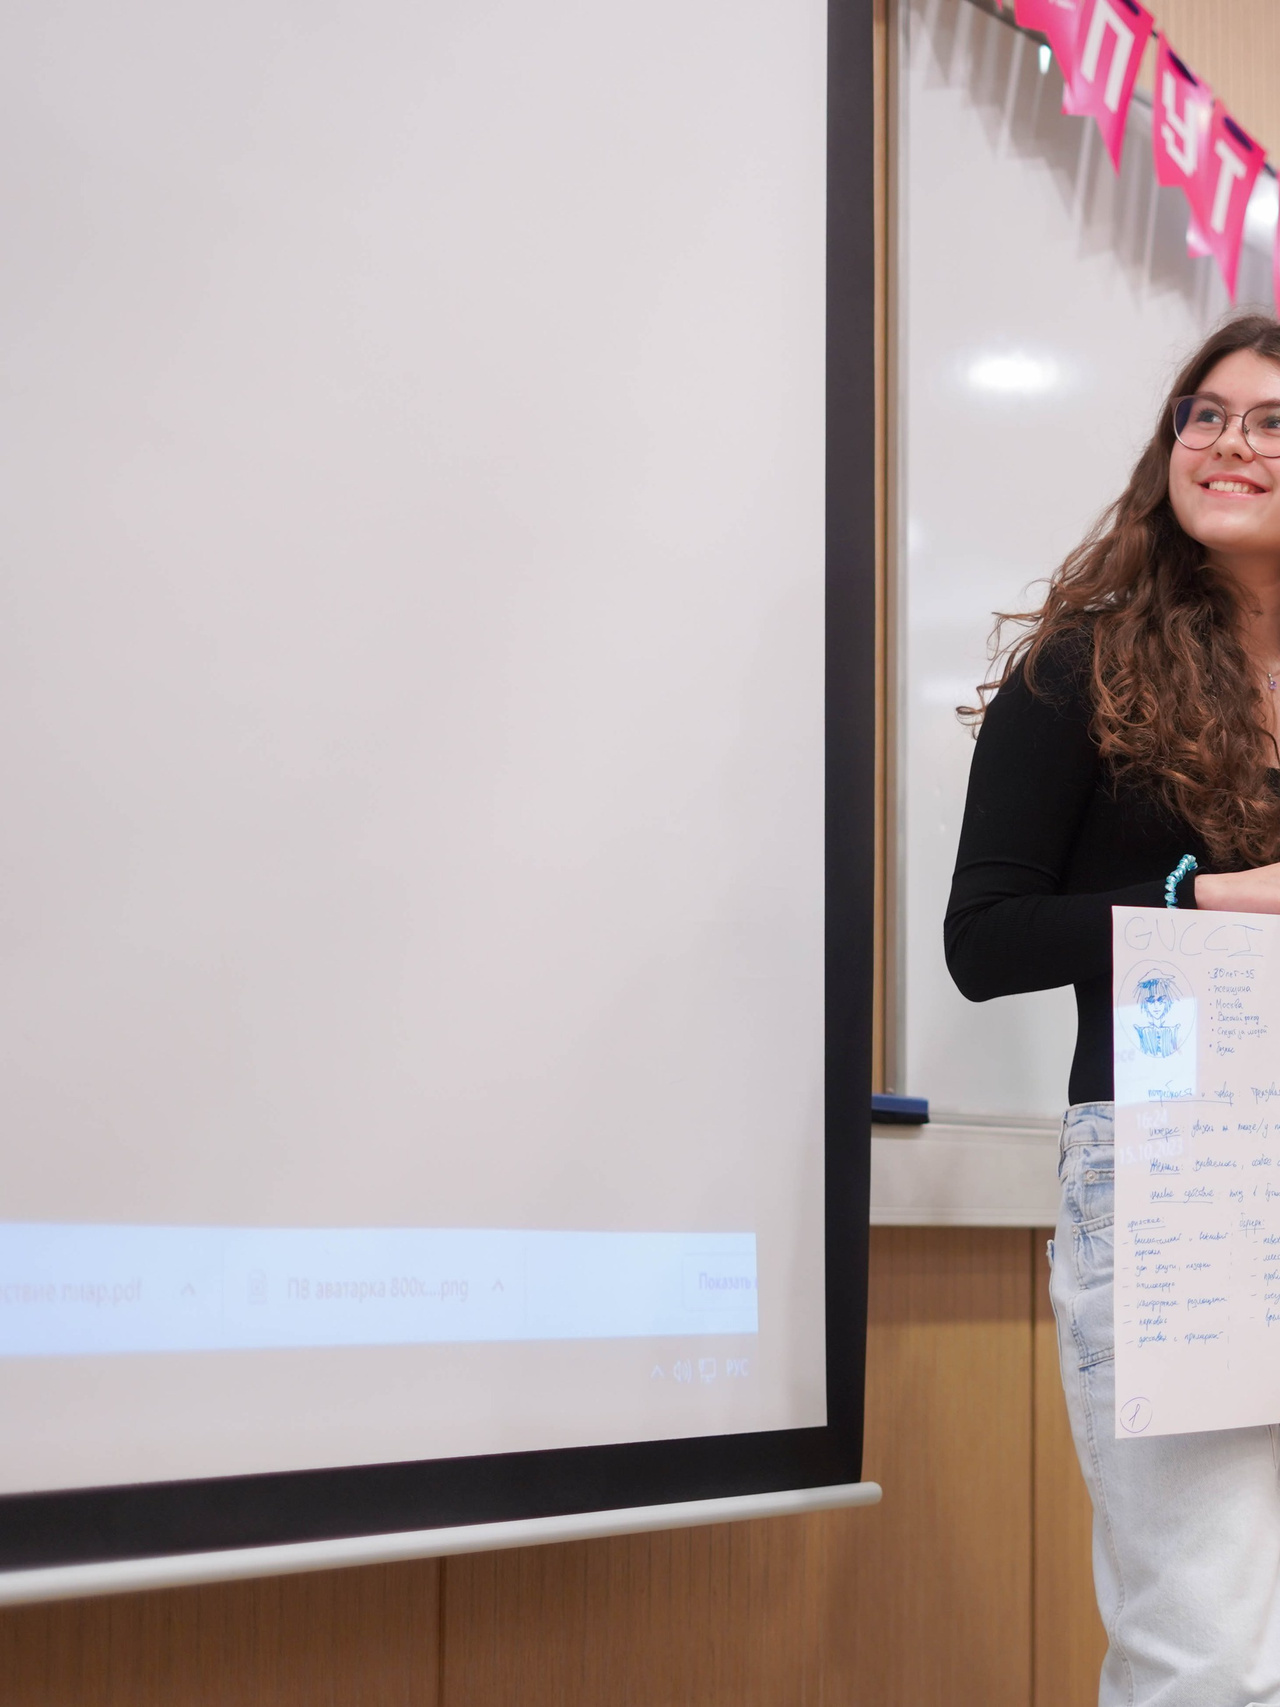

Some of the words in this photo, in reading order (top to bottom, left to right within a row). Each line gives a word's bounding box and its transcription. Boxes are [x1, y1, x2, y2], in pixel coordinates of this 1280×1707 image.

[1124, 916, 1264, 958] GUCCI
[1213, 985, 1252, 996] женщина
[1215, 998, 1244, 1010] Москва
[1238, 1030, 1246, 1040] за
[698, 1271, 752, 1291] Показать
[0, 1283, 56, 1305] ствие
[315, 1278, 386, 1304] аватарка
[725, 1359, 749, 1376] РУС
